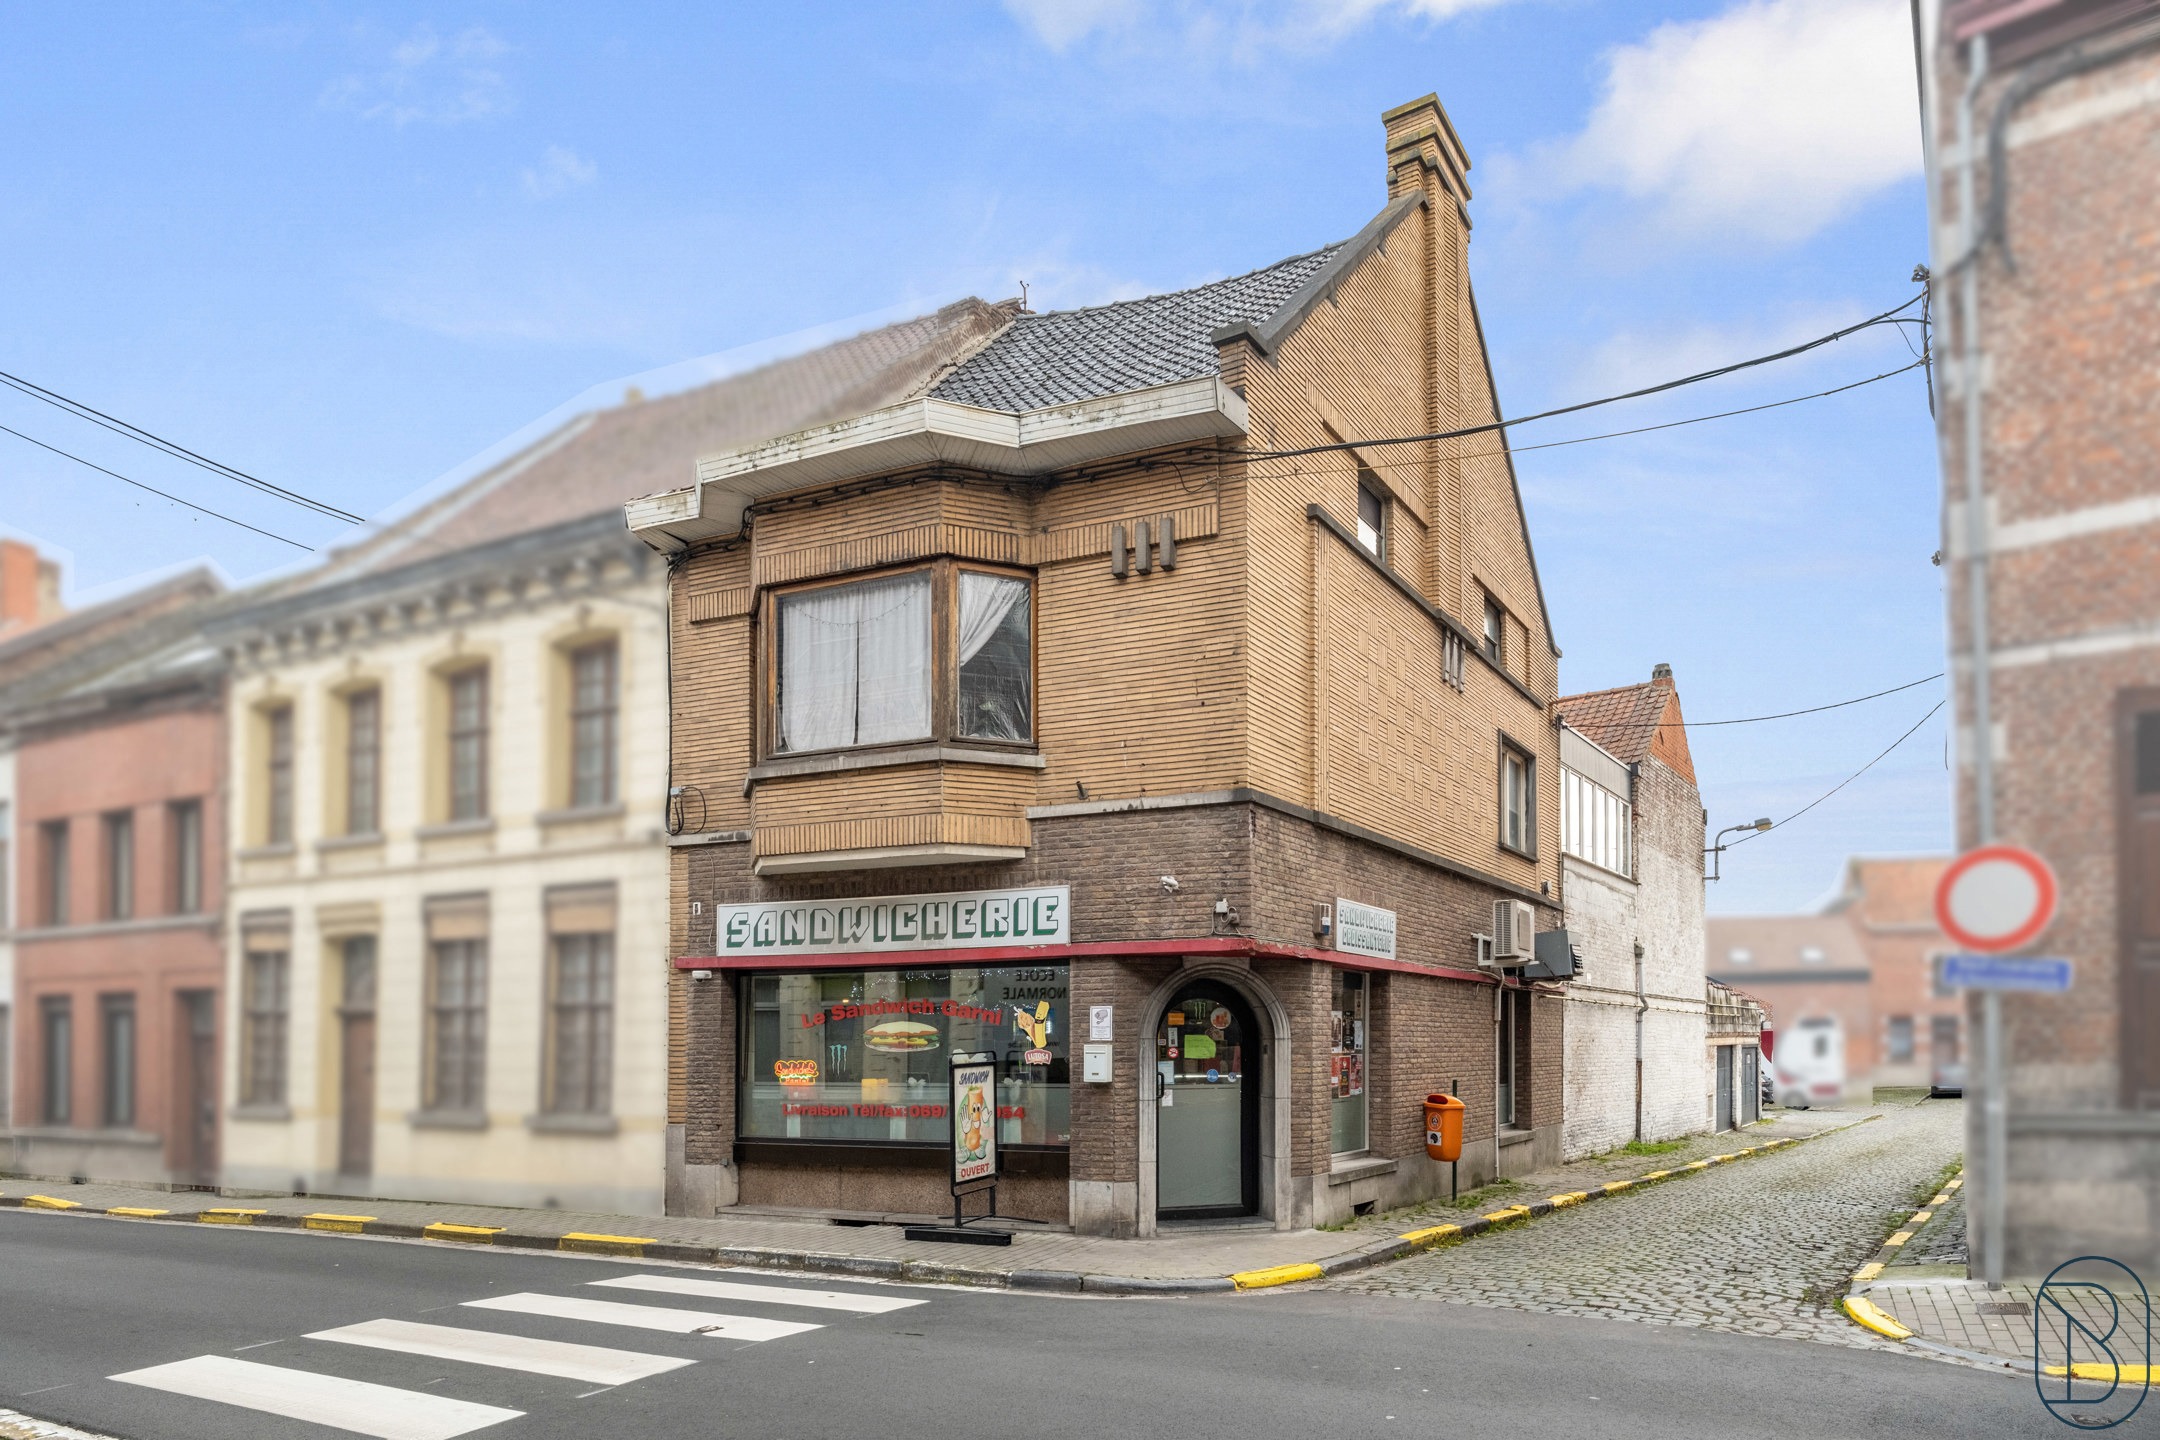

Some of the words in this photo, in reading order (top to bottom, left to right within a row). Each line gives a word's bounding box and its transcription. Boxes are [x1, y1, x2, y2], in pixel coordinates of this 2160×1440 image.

[726, 896, 1059, 948] SANDWICHERIE
[1339, 906, 1394, 934] SANDWICHERIE
[801, 1012, 826, 1029] Le
[831, 998, 935, 1021] Sandwich
[941, 999, 1003, 1025] Garni
[1027, 1052, 1049, 1061] LUTOSA
[959, 1070, 990, 1085] SANDWICH
[782, 1104, 848, 1117] Livraison
[909, 1103, 948, 1118] 069/
[961, 1163, 990, 1178] OUVERT
